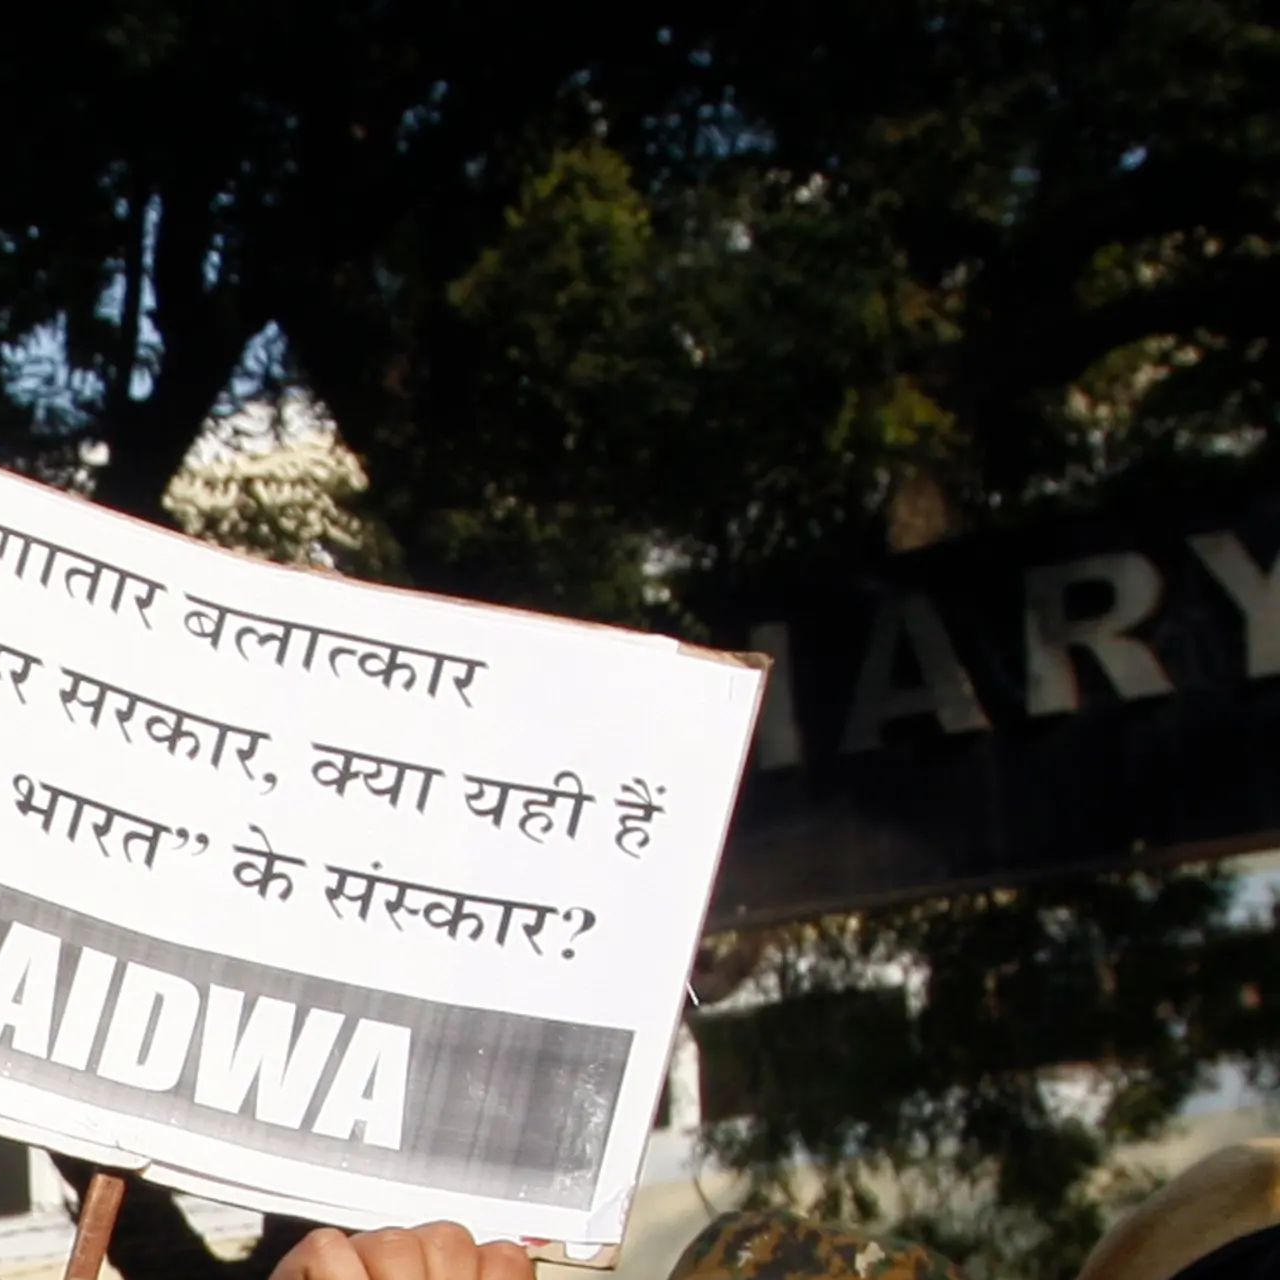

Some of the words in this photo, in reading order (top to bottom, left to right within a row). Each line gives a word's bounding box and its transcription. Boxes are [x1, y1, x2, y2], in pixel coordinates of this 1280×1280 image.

[181, 590, 488, 708] बलात्कार
[58, 664, 280, 796] सरकार,
[308, 741, 446, 811] क्या
[462, 770, 596, 846] यही
[612, 776, 668, 859] हैं
[232, 825, 307, 906] के
[323, 859, 597, 963] संस्कार?
